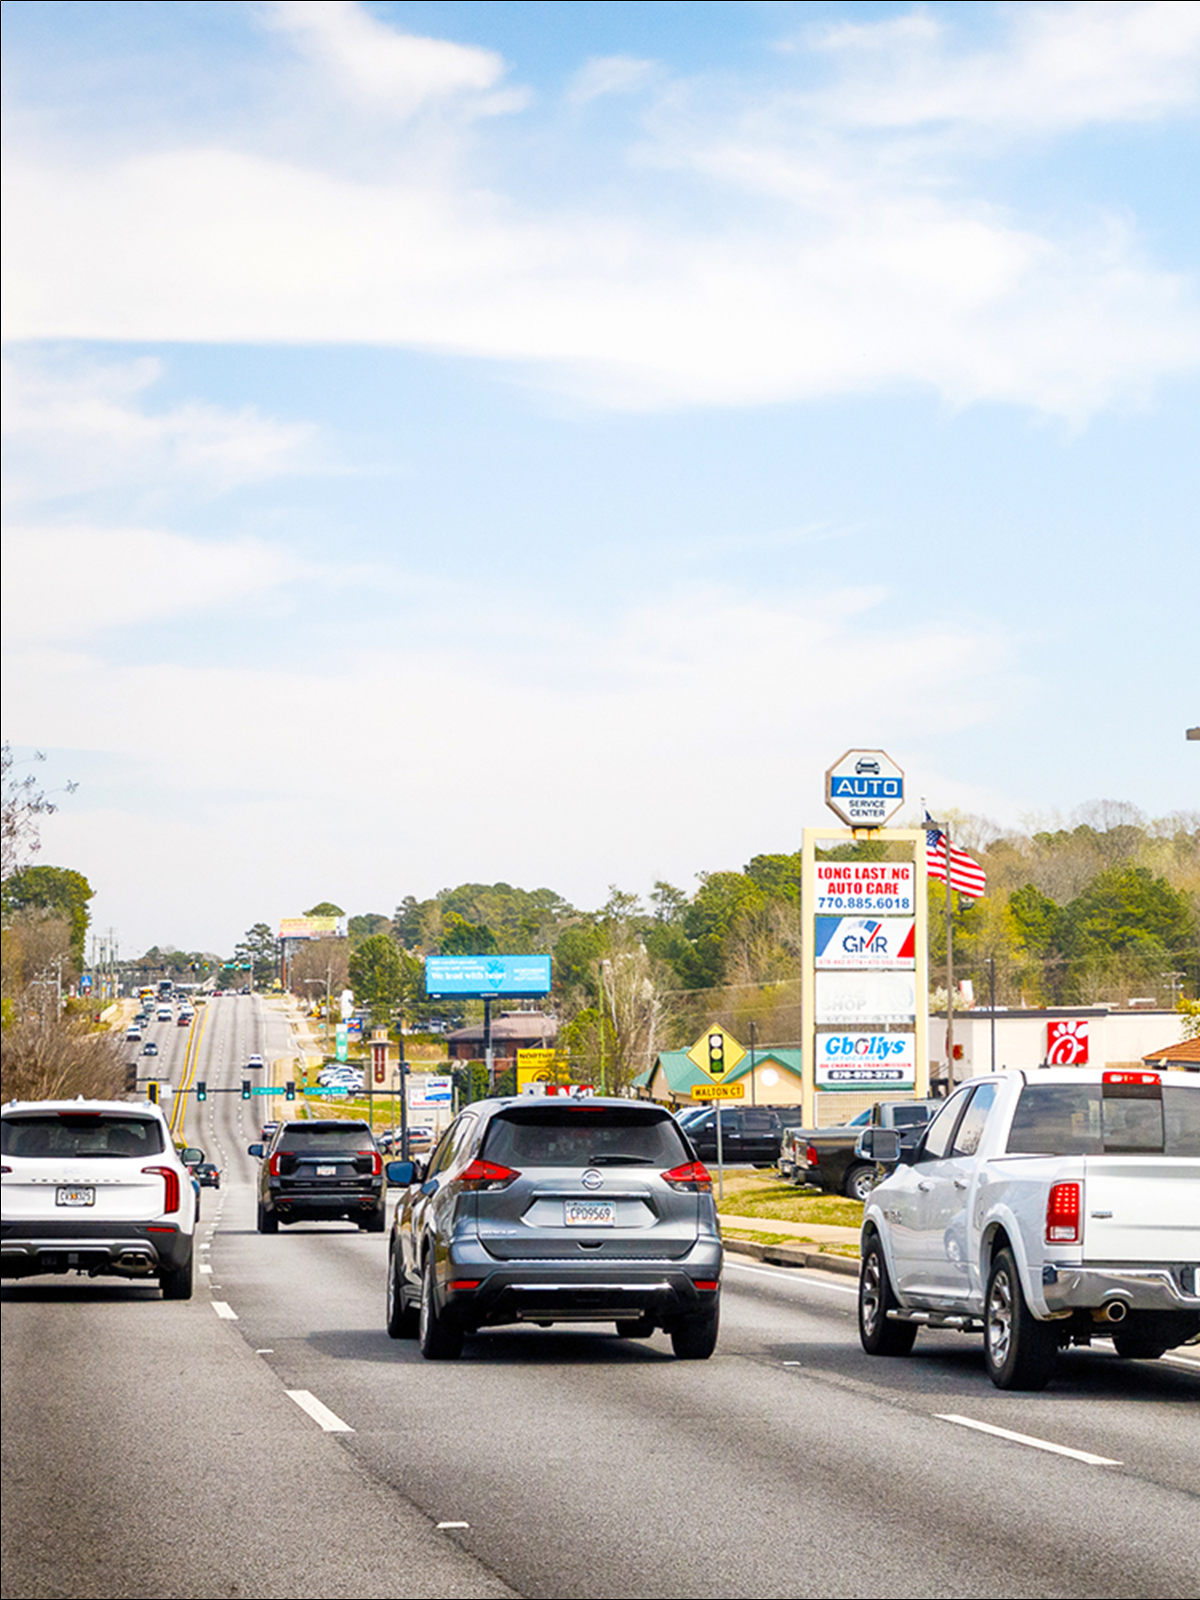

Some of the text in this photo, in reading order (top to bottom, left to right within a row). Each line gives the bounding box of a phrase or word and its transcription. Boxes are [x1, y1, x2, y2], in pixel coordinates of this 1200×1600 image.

[836, 779, 898, 795] AUTO
[848, 800, 886, 808] SERVICE
[849, 809, 885, 817] CENTER
[818, 867, 910, 880] LONG LASTNG
[827, 882, 899, 895] AUTO CARE
[818, 897, 910, 909] 770.885.6018
[695, 1087, 741, 1097] WALTON CT
